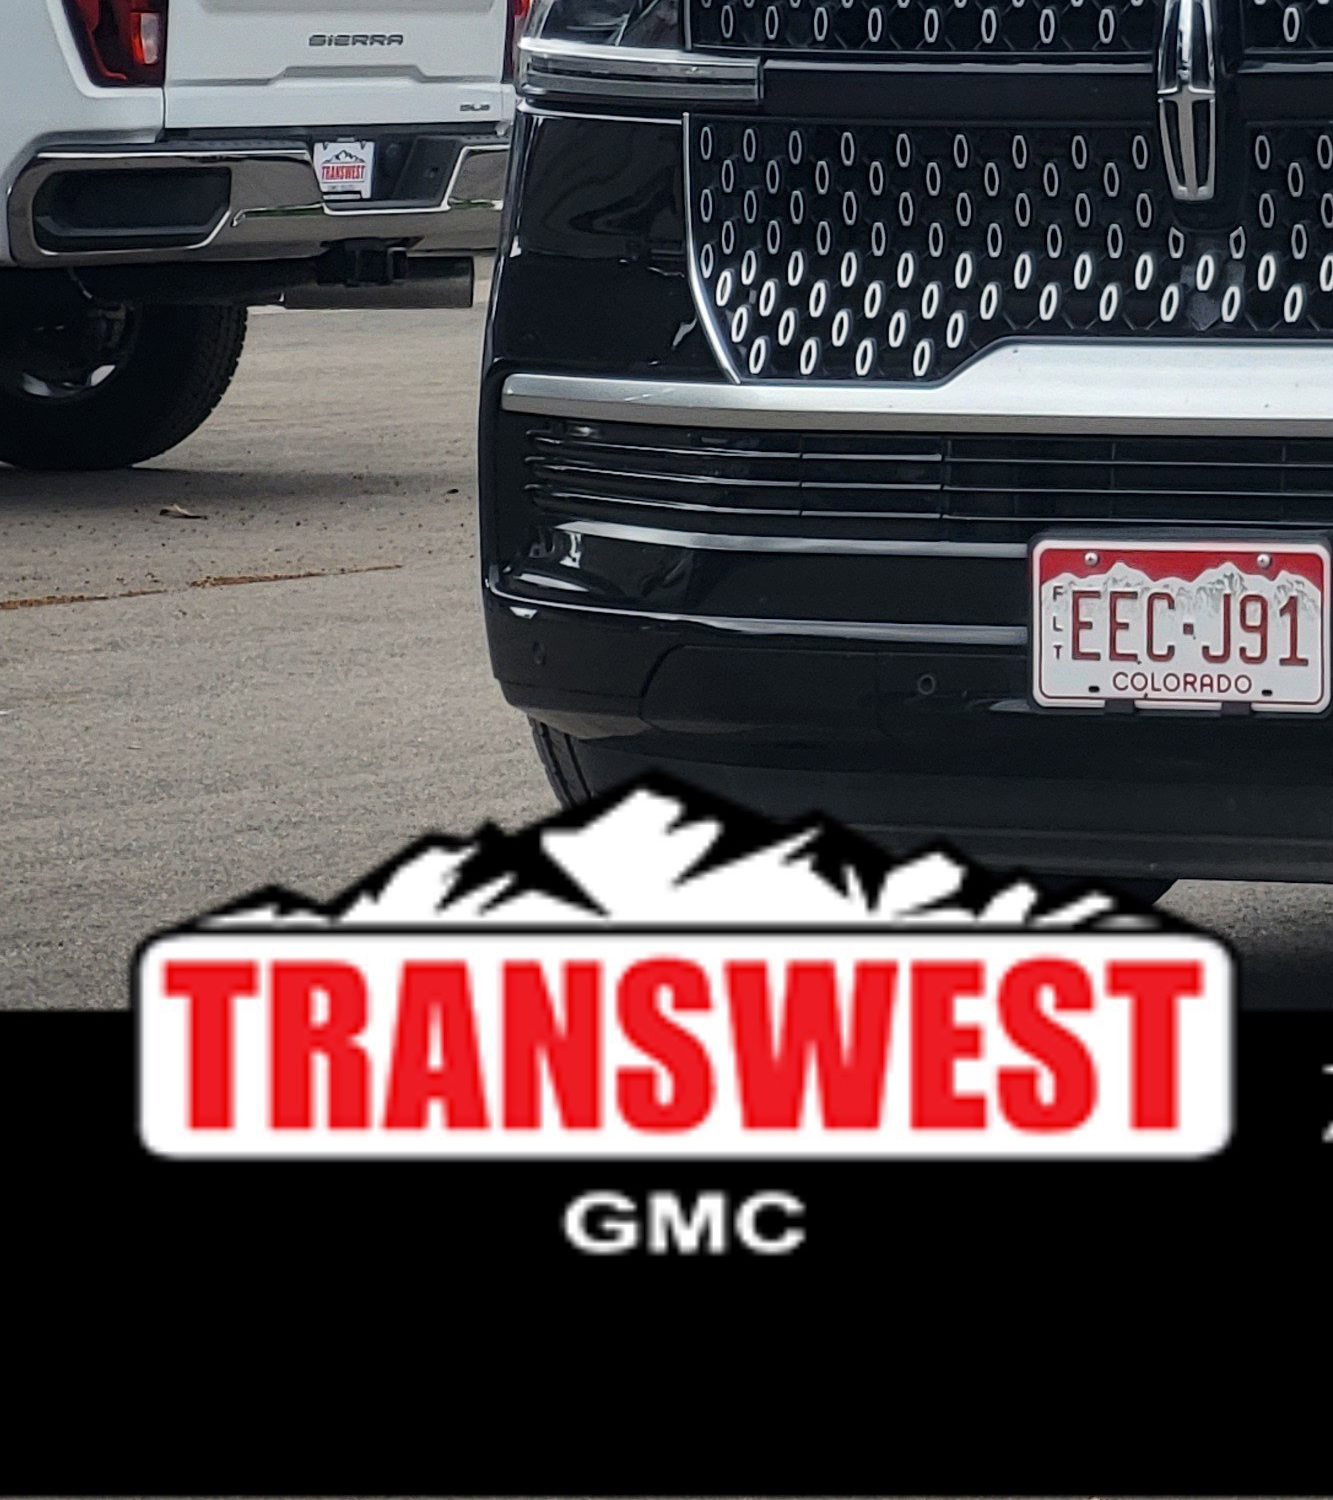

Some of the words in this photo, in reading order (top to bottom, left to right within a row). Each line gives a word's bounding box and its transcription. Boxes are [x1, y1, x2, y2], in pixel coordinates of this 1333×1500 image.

[308, 34, 404, 47] SIERRA
[322, 165, 366, 180] TRANSWEST
[1113, 671, 1253, 695] COLORADO
